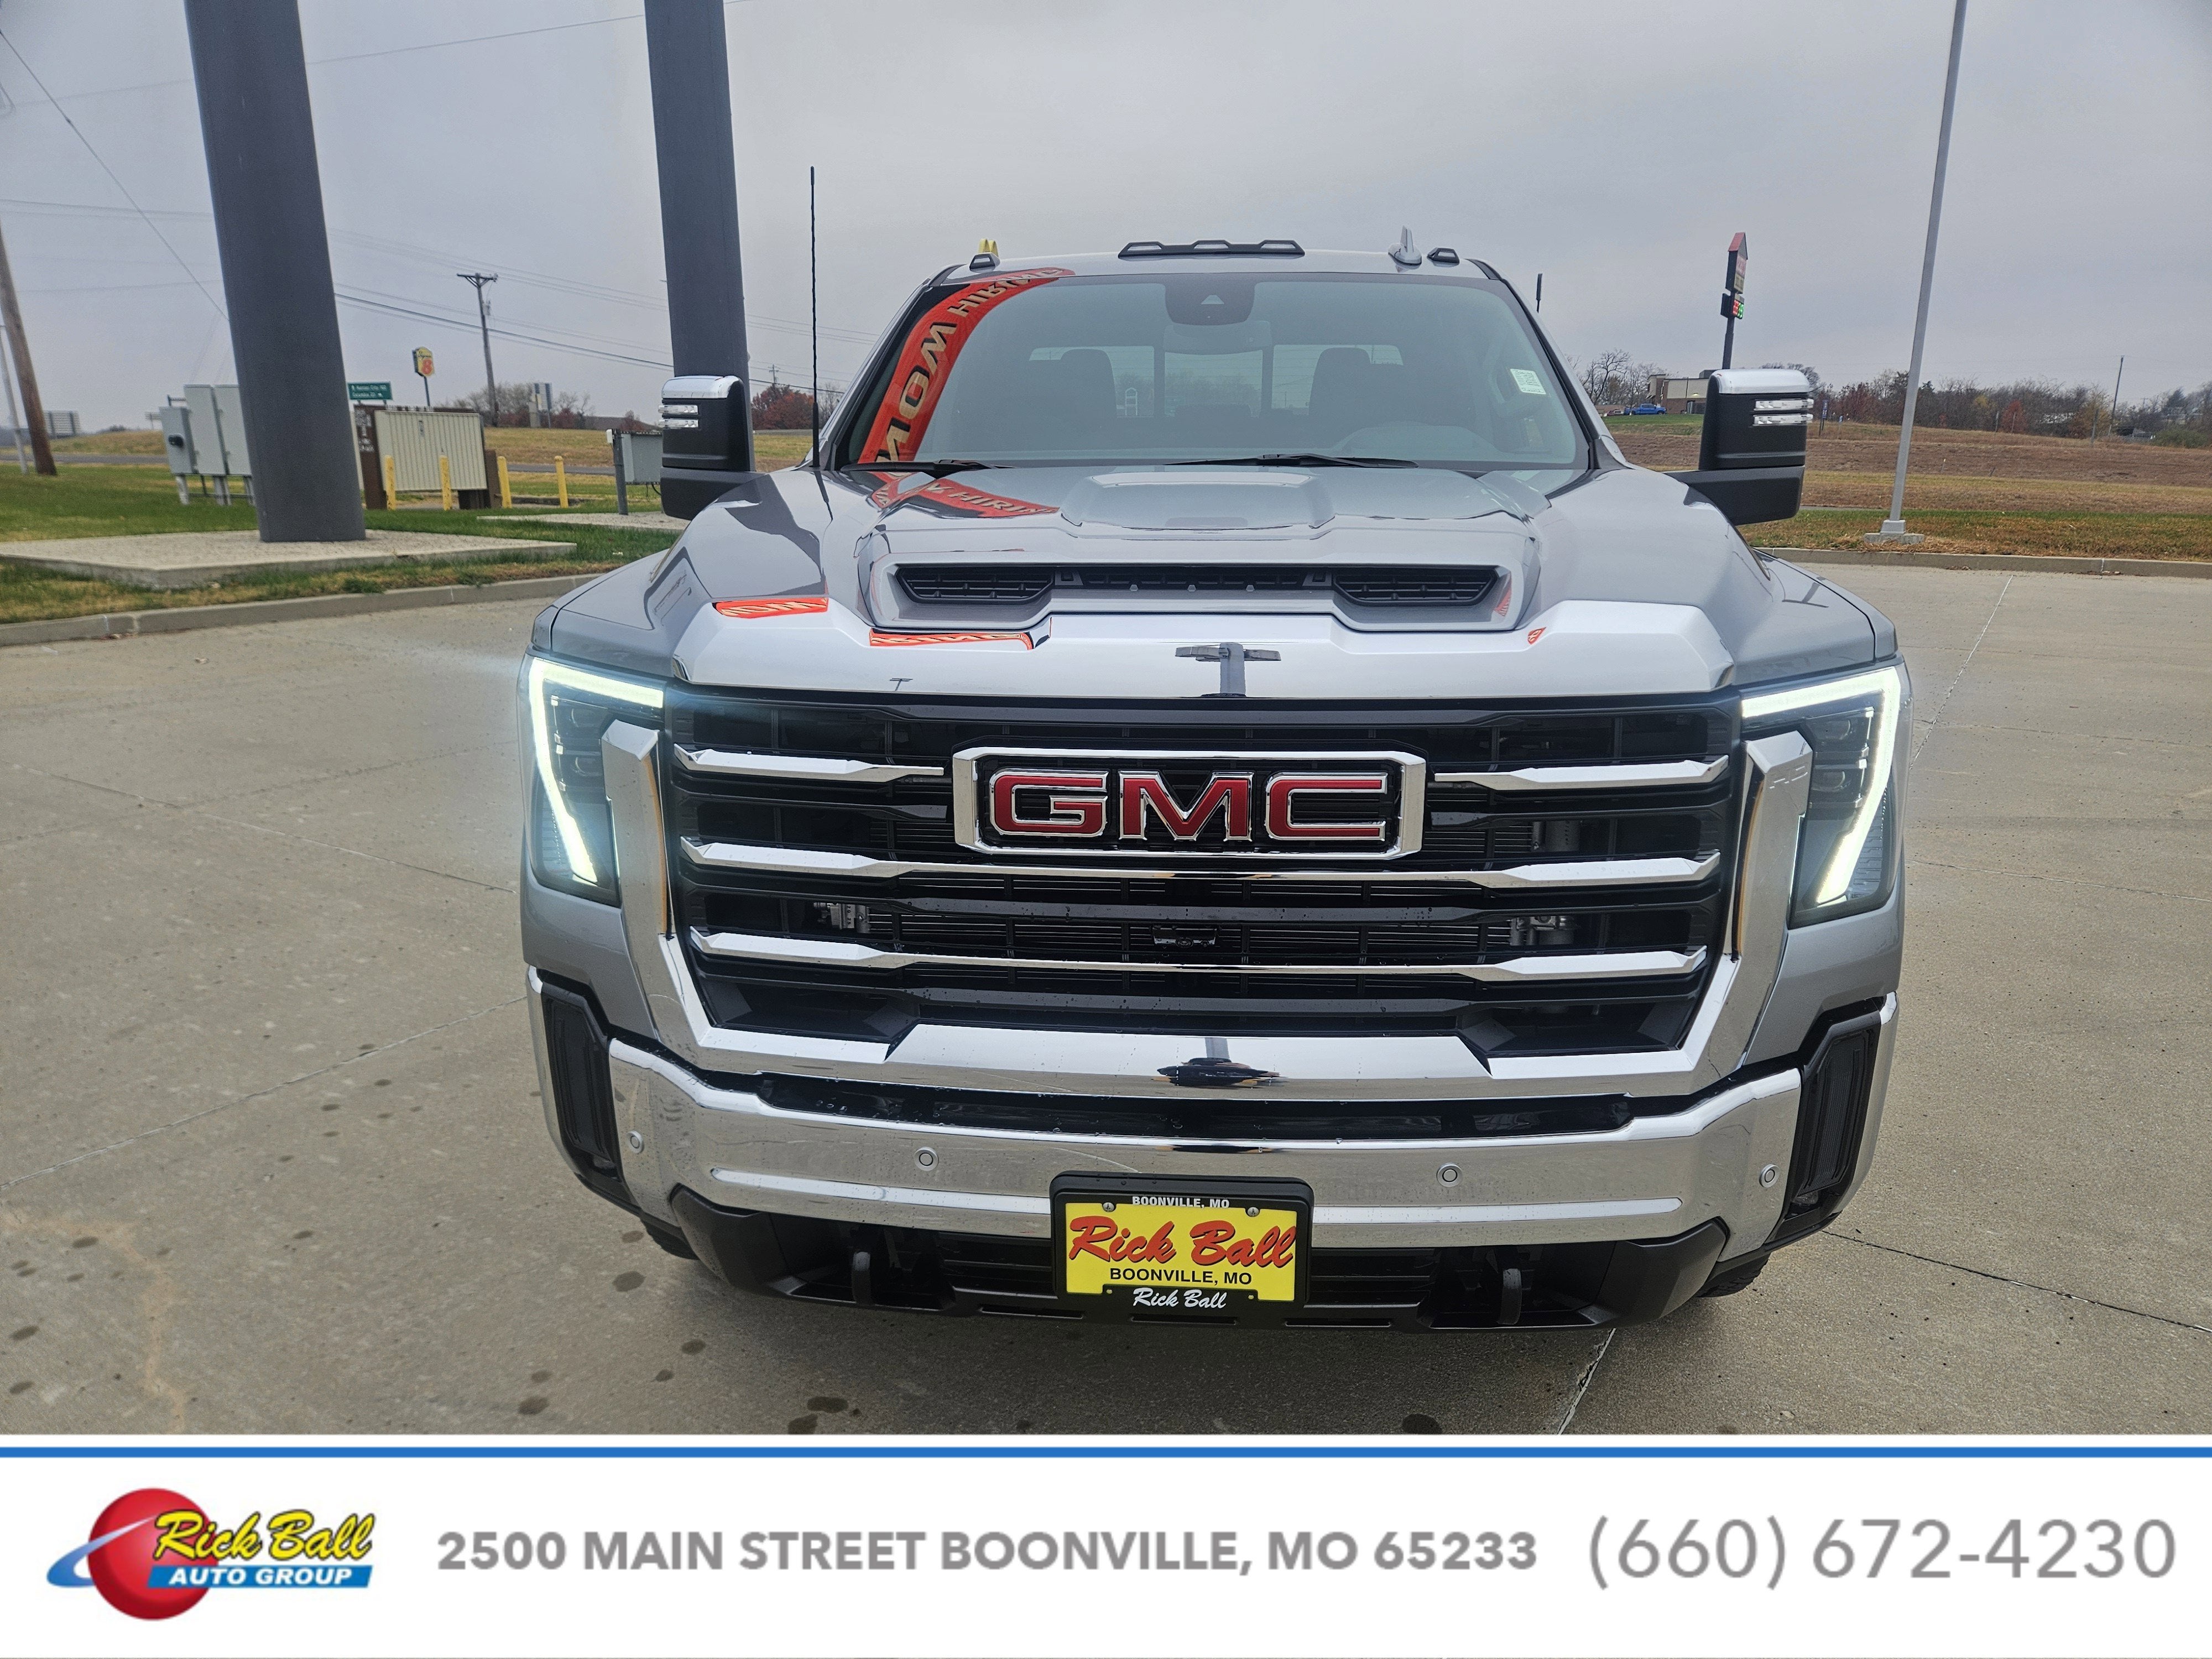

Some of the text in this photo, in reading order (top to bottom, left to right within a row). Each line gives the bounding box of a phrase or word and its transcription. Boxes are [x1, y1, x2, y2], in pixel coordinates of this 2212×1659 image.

[422, 358, 432, 374] 8
[989, 768, 1388, 842] GMC
[1132, 1196, 1230, 1209] BOONVILLE, MO
[1068, 1215, 1296, 1268] Rick Ball
[1110, 1267, 1253, 1286] BOONVILLE, MO
[1132, 1287, 1227, 1309] Rick Ball
